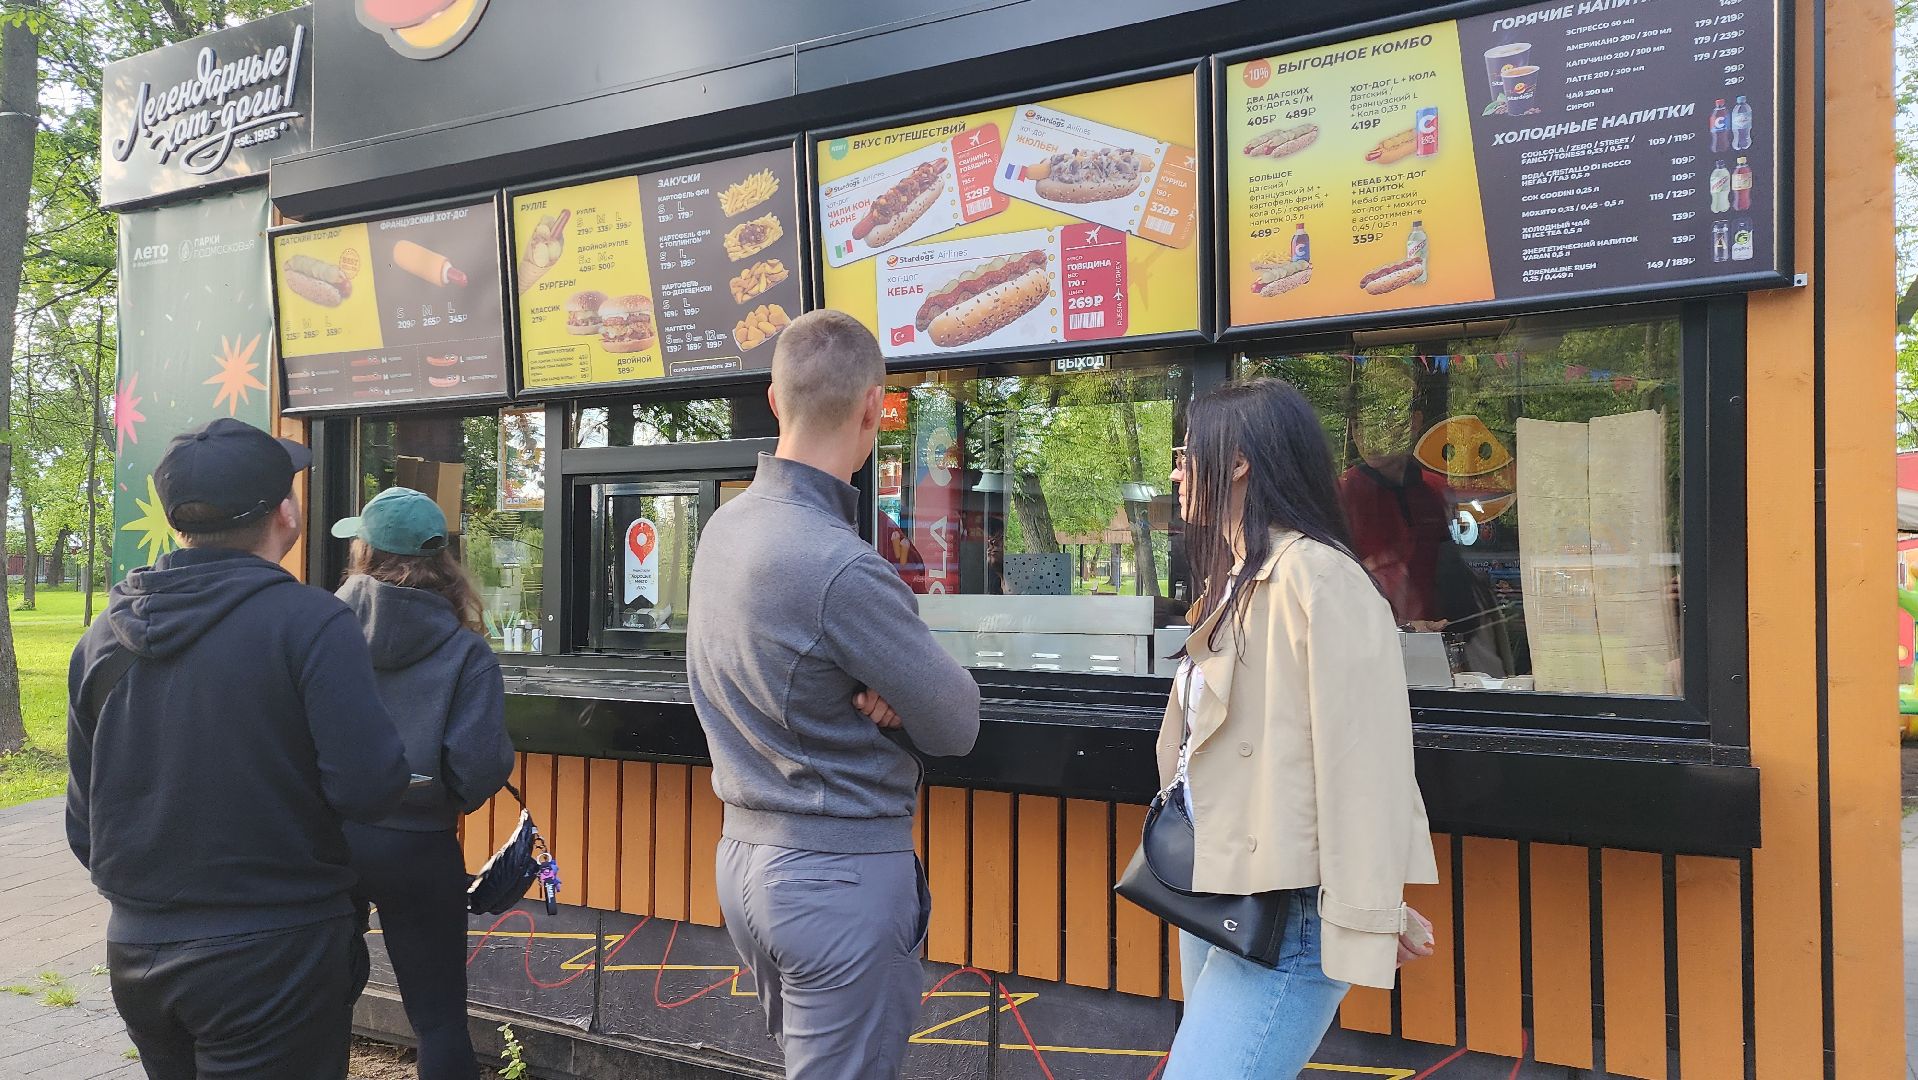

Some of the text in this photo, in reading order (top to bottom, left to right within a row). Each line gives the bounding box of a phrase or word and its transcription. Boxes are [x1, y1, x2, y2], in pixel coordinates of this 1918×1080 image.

[1491, 4, 1575, 33] ГОРЯЧИЕ
[1694, 12, 1745, 28] 179 219₽
[1565, 19, 1622, 36] ЭСПРЕССО 60
[1565, 28, 1659, 52] АМЕРИКАНО 200 300
[1693, 29, 1745, 45] 179 239₽
[1277, 34, 1433, 75] ВЫГОДНОЕ КОМБО
[1565, 54, 1613, 68] КАПУЧИНО
[1613, 50, 1629, 60] 200
[1693, 46, 1745, 62] 179 239₽
[1244, 66, 1270, 81] -10%
[1723, 63, 1745, 74] 99₽
[1349, 69, 1437, 94] ХОТ-ДОГ КОЛА
[1565, 71, 1610, 84] ЛАТТЕ 200
[1724, 75, 1745, 86] 29₽
[1246, 86, 1309, 105] ДВА ДАТСКИХ
[1350, 88, 1388, 102] Датский
[1565, 89, 1584, 100] ЧАЙ
[112, 46, 288, 161] Легендарные
[1246, 99, 1290, 113] ХОТ-ДОГА
[1565, 101, 1595, 112] СИРОП
[1247, 106, 1317, 127] 405₽ 489₽
[1357, 104, 1398, 119] Кола 0,33
[1035, 112, 1065, 128] Stardogs
[1350, 118, 1382, 131] 419₽
[1491, 102, 1696, 147] ХОЛОДНЫЕ НАПИТКИ
[853, 120, 967, 151] ВКУС ПУТЕШЕСТВИЙ
[1648, 132, 1696, 147] 109 119₽
[1016, 134, 1060, 153] ЖЮЛЬЕН
[1521, 135, 1630, 160] COOLCOLA ZERO STREET
[1521, 155, 1549, 165] FANCY
[1671, 155, 1696, 165] 109₽
[1249, 170, 1293, 184] БОЛЬШОЕ
[1521, 159, 1632, 181] ВОДА CRISTALLO ROCCO
[1671, 172, 1696, 183] 109₽
[657, 173, 701, 188] ЗАКУСКИ
[833, 179, 860, 193] Stardogs
[1160, 174, 1188, 189] КУРИЦА
[1351, 169, 1427, 188] КЕБАБ ХОТ-ДОГ
[1521, 173, 1570, 187] НЕГАЗ ГАЗ
[964, 186, 991, 201] 329₽
[1249, 180, 1284, 194] Датский
[1358, 182, 1405, 196] НАПИТОК
[1521, 187, 1593, 202] СОК GOODINI 0,25
[1649, 188, 1696, 201] 119 129₽
[657, 188, 710, 203] КАРТОФЕЛЬ ФРИ
[1249, 187, 1305, 203] французский
[1249, 193, 1314, 211] картофель фри
[1351, 190, 1418, 206] Кебаб датский
[520, 201, 547, 212] РУЛЛЕ
[576, 207, 596, 215] РУЛЛЕ
[677, 201, 685, 212] L
[827, 199, 872, 219] ЧИЛИ КОН
[1150, 201, 1180, 218] 329₽
[1249, 209, 1269, 219] кола
[1270, 206, 1283, 217] 0,5
[1351, 198, 1427, 215] хот-дог мохито
[1521, 199, 1617, 218] МОХИТО 0,33 0,45 0,5
[380, 209, 469, 230] ФРАНЦУЗСКИЙ ХОТ-ДОГ
[828, 213, 857, 229] КАРНЕ
[1249, 215, 1284, 228] напиток
[1358, 208, 1423, 224] ассортименте
[1671, 211, 1696, 222] 139₽
[1250, 226, 1281, 239] 489₽
[1352, 220, 1391, 233] 0,45 0,5
[1521, 218, 1590, 235] ХОЛОДНЫЙ ЧАЙ
[1532, 227, 1576, 239] ICE TEA 0,5
[659, 232, 696, 243] КАРТОФЕЛЬ
[665, 237, 702, 248] ТОППИНГОМ
[1352, 231, 1384, 245] 359₽
[1672, 234, 1696, 245] 139₽
[577, 239, 629, 253] ДВОЙНОЙ РУЛЛЕ
[1522, 235, 1639, 256] ЭНЕРГЕТИЧЕСКИЙ НАПИТОК
[899, 249, 968, 265] Stardogs Airlines
[1522, 250, 1565, 262] VARAN 0,5
[1647, 257, 1696, 270] 149 189₽
[1067, 259, 1112, 272] ГОВЯДИНА
[1522, 262, 1597, 278] ADRENALINE RUSH
[1114, 260, 1122, 288] TURKEY
[1522, 272, 1568, 284] 0,25 0,449
[539, 279, 577, 291] БУРГЕРЫ
[661, 280, 699, 291] КАРТОФЕЛЬ
[887, 284, 924, 298] КЕБАБ
[1067, 280, 1080, 288] 170
[530, 304, 561, 315] КЛАССИК
[1068, 294, 1104, 310] 269₽
[617, 354, 652, 366] ДВОЙНОЙ
[1057, 354, 1105, 370] ВЫХОД
